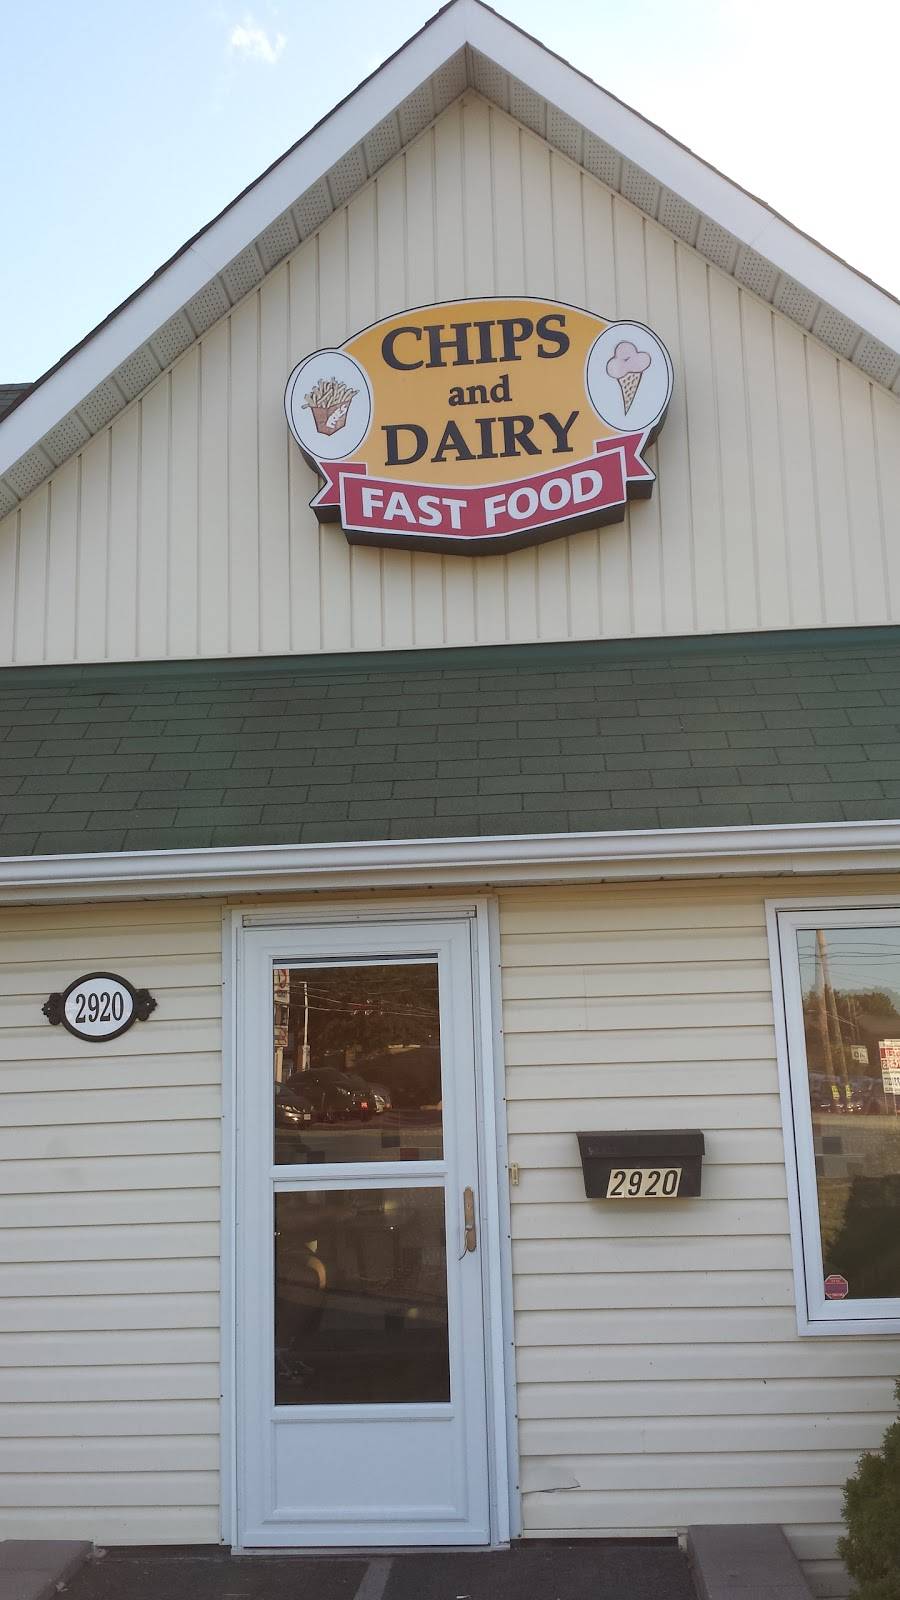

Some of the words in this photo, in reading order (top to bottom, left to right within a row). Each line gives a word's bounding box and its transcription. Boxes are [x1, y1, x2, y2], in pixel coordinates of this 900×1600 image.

[381, 313, 570, 371] CHIPS
[448, 374, 513, 406] and
[381, 410, 580, 466] DAIRY
[361, 487, 467, 530] FAST
[485, 469, 603, 528] FOOD
[75, 991, 124, 1023] 2920
[610, 1169, 678, 1196] 2920
